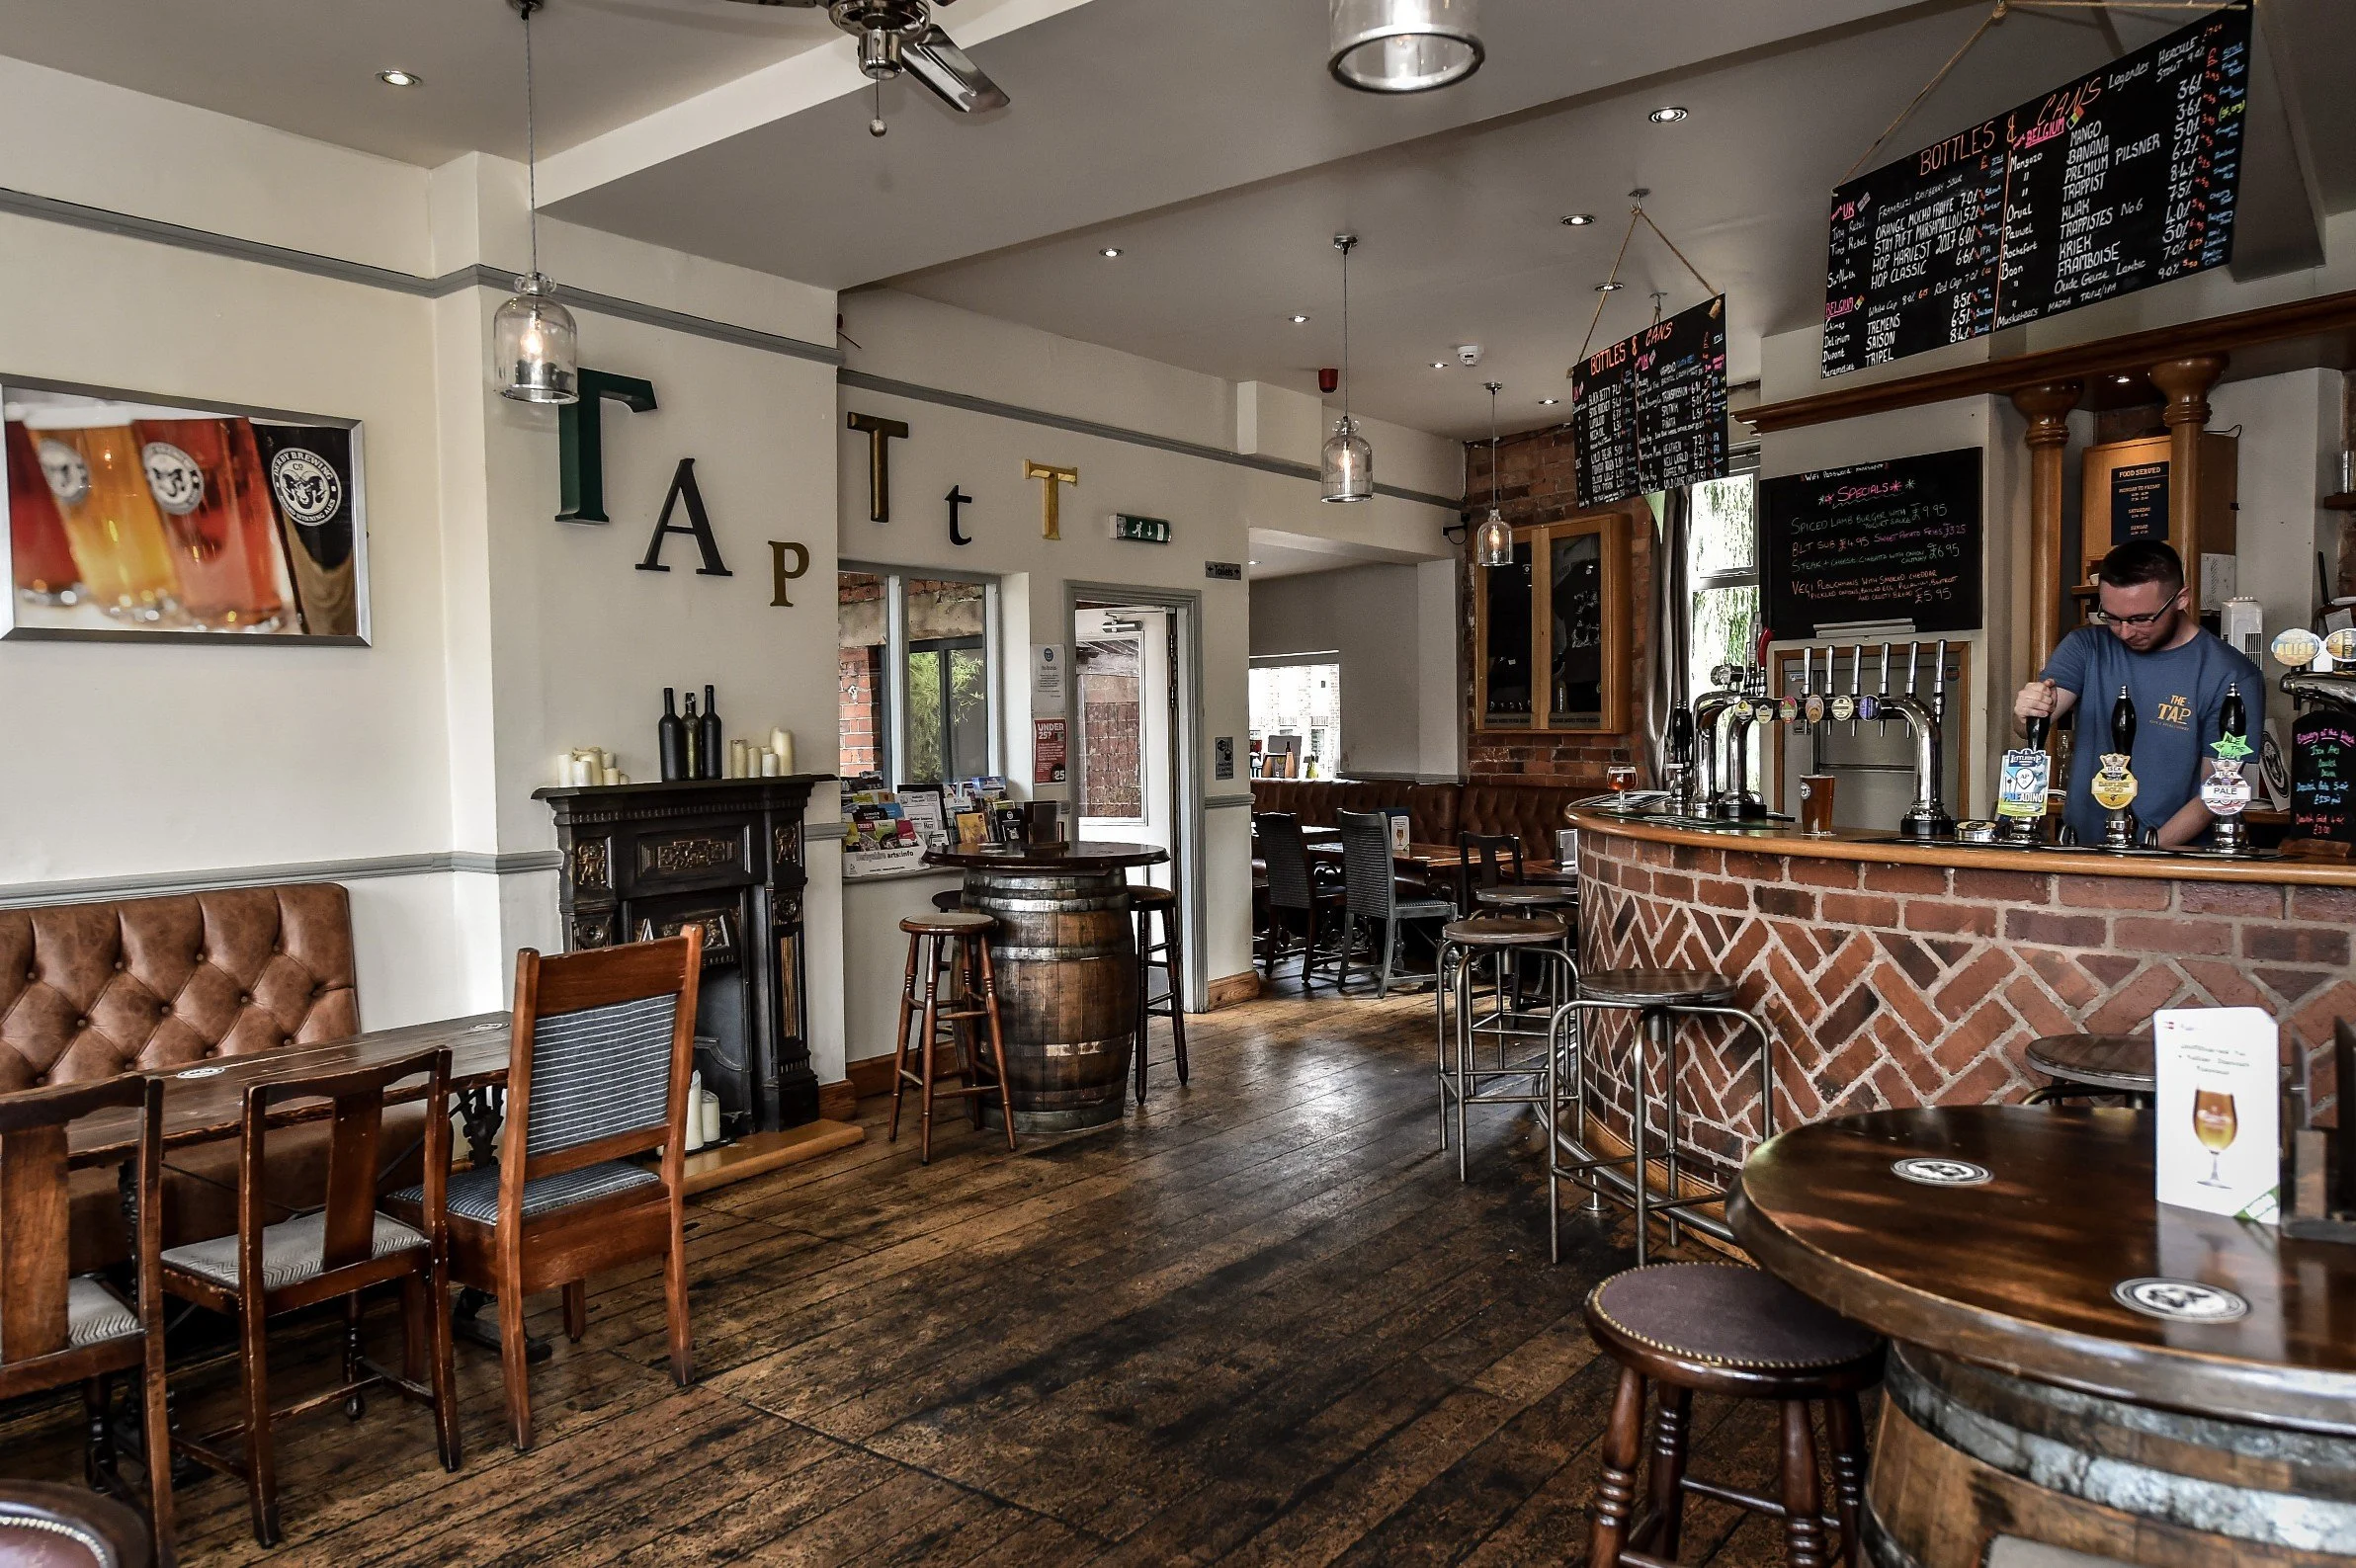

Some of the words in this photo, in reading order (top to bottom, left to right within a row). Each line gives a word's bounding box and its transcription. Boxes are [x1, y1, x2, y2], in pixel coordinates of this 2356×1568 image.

[1920, 121, 1994, 176] BOTTLES
[2037, 76, 2101, 126] CANS
[2025, 117, 2064, 147] BELGIUM
[2069, 120, 2102, 147] MANGO
[2064, 153, 2109, 185] PREMIUM
[2115, 132, 2160, 166] PILSNER
[2066, 134, 2110, 165] BANANA
[2007, 203, 2033, 223] Orval
[2062, 171, 2106, 202] TRAPPIST
[1842, 201, 1855, 220] UK
[2004, 222, 2034, 241] Pauwel
[2061, 198, 2090, 222] KWAK
[1830, 242, 1844, 257] Tiny
[1848, 234, 1867, 250] Rebel
[1876, 216, 1905, 241] ORANGE
[1907, 206, 1931, 226] MOCHA
[1932, 197, 1954, 217] FRAPPE
[1874, 234, 1893, 256] STAY
[1894, 228, 1914, 249] PUFT
[1915, 213, 1964, 242] MARSHMALLOW
[2002, 240, 2038, 261] Rochefort
[2060, 206, 2114, 240] TRAPPISTES
[1872, 254, 1891, 273] HOP
[1893, 239, 1932, 268] HARVEST
[1935, 230, 1957, 255] 2017
[2000, 262, 2024, 281] Boon
[2059, 233, 2092, 261] KRIEK
[2057, 240, 2121, 279] FRAMBOISE
[1870, 273, 1889, 289] HOP
[1890, 259, 1927, 284] CLASSIC
[2055, 278, 2078, 294] Oude
[1867, 312, 1900, 335] TREMENS
[1590, 342, 1626, 376] BOTTLES
[1645, 321, 1673, 347] CANS
[1865, 330, 1895, 352] SAISON
[1865, 348, 1894, 368] TRIPEL
[291, 452, 334, 480] BREWING
[2119, 469, 2135, 478] FOOD
[2136, 466, 2161, 476] SERVED
[1837, 482, 1889, 501] SPECIALS
[324, 498, 336, 515] ALES
[1791, 517, 1828, 535] SPICED
[1830, 515, 1853, 528] LAMB
[1792, 541, 1813, 557] BLT
[1215, 564, 1232, 576] Toilets
[1792, 559, 1821, 573] STEAK
[2170, 695, 2187, 706] THE
[2157, 702, 2192, 723] TAP
[1037, 722, 1064, 732] UNDER
[1038, 731, 1052, 740] 25?
[2225, 736, 2241, 745] ALE
[1053, 770, 1065, 781] 25
